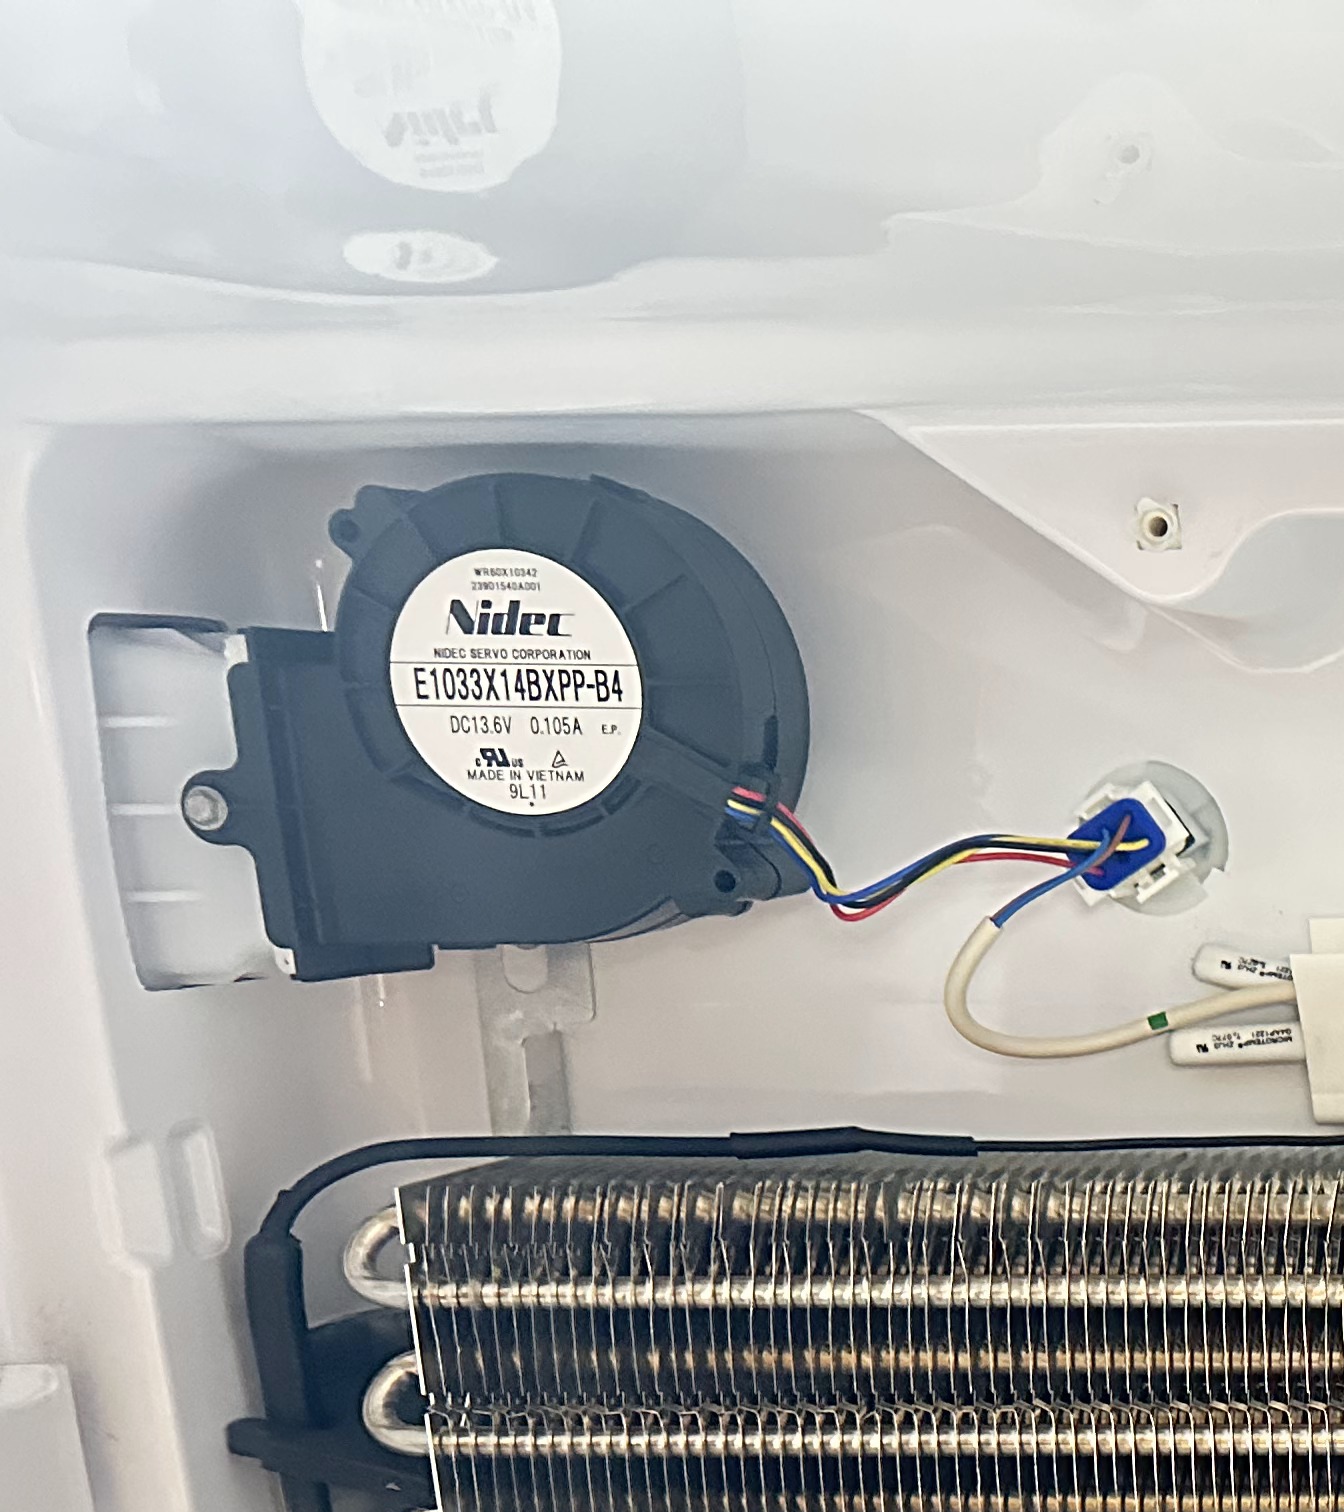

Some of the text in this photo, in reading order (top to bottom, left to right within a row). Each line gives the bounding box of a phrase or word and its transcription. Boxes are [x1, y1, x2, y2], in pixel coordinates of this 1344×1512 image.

[446, 599, 575, 637] Nidec
[433, 647, 592, 661] NIDEC SERVO CORPORATION
[414, 667, 623, 702] E1033X14BXPP-B4
[450, 715, 512, 734] DC13.6V
[530, 716, 583, 735] 0.105A
[467, 769, 585, 782] MADE IN VIETNAM
[509, 783, 547, 800] 9L11
